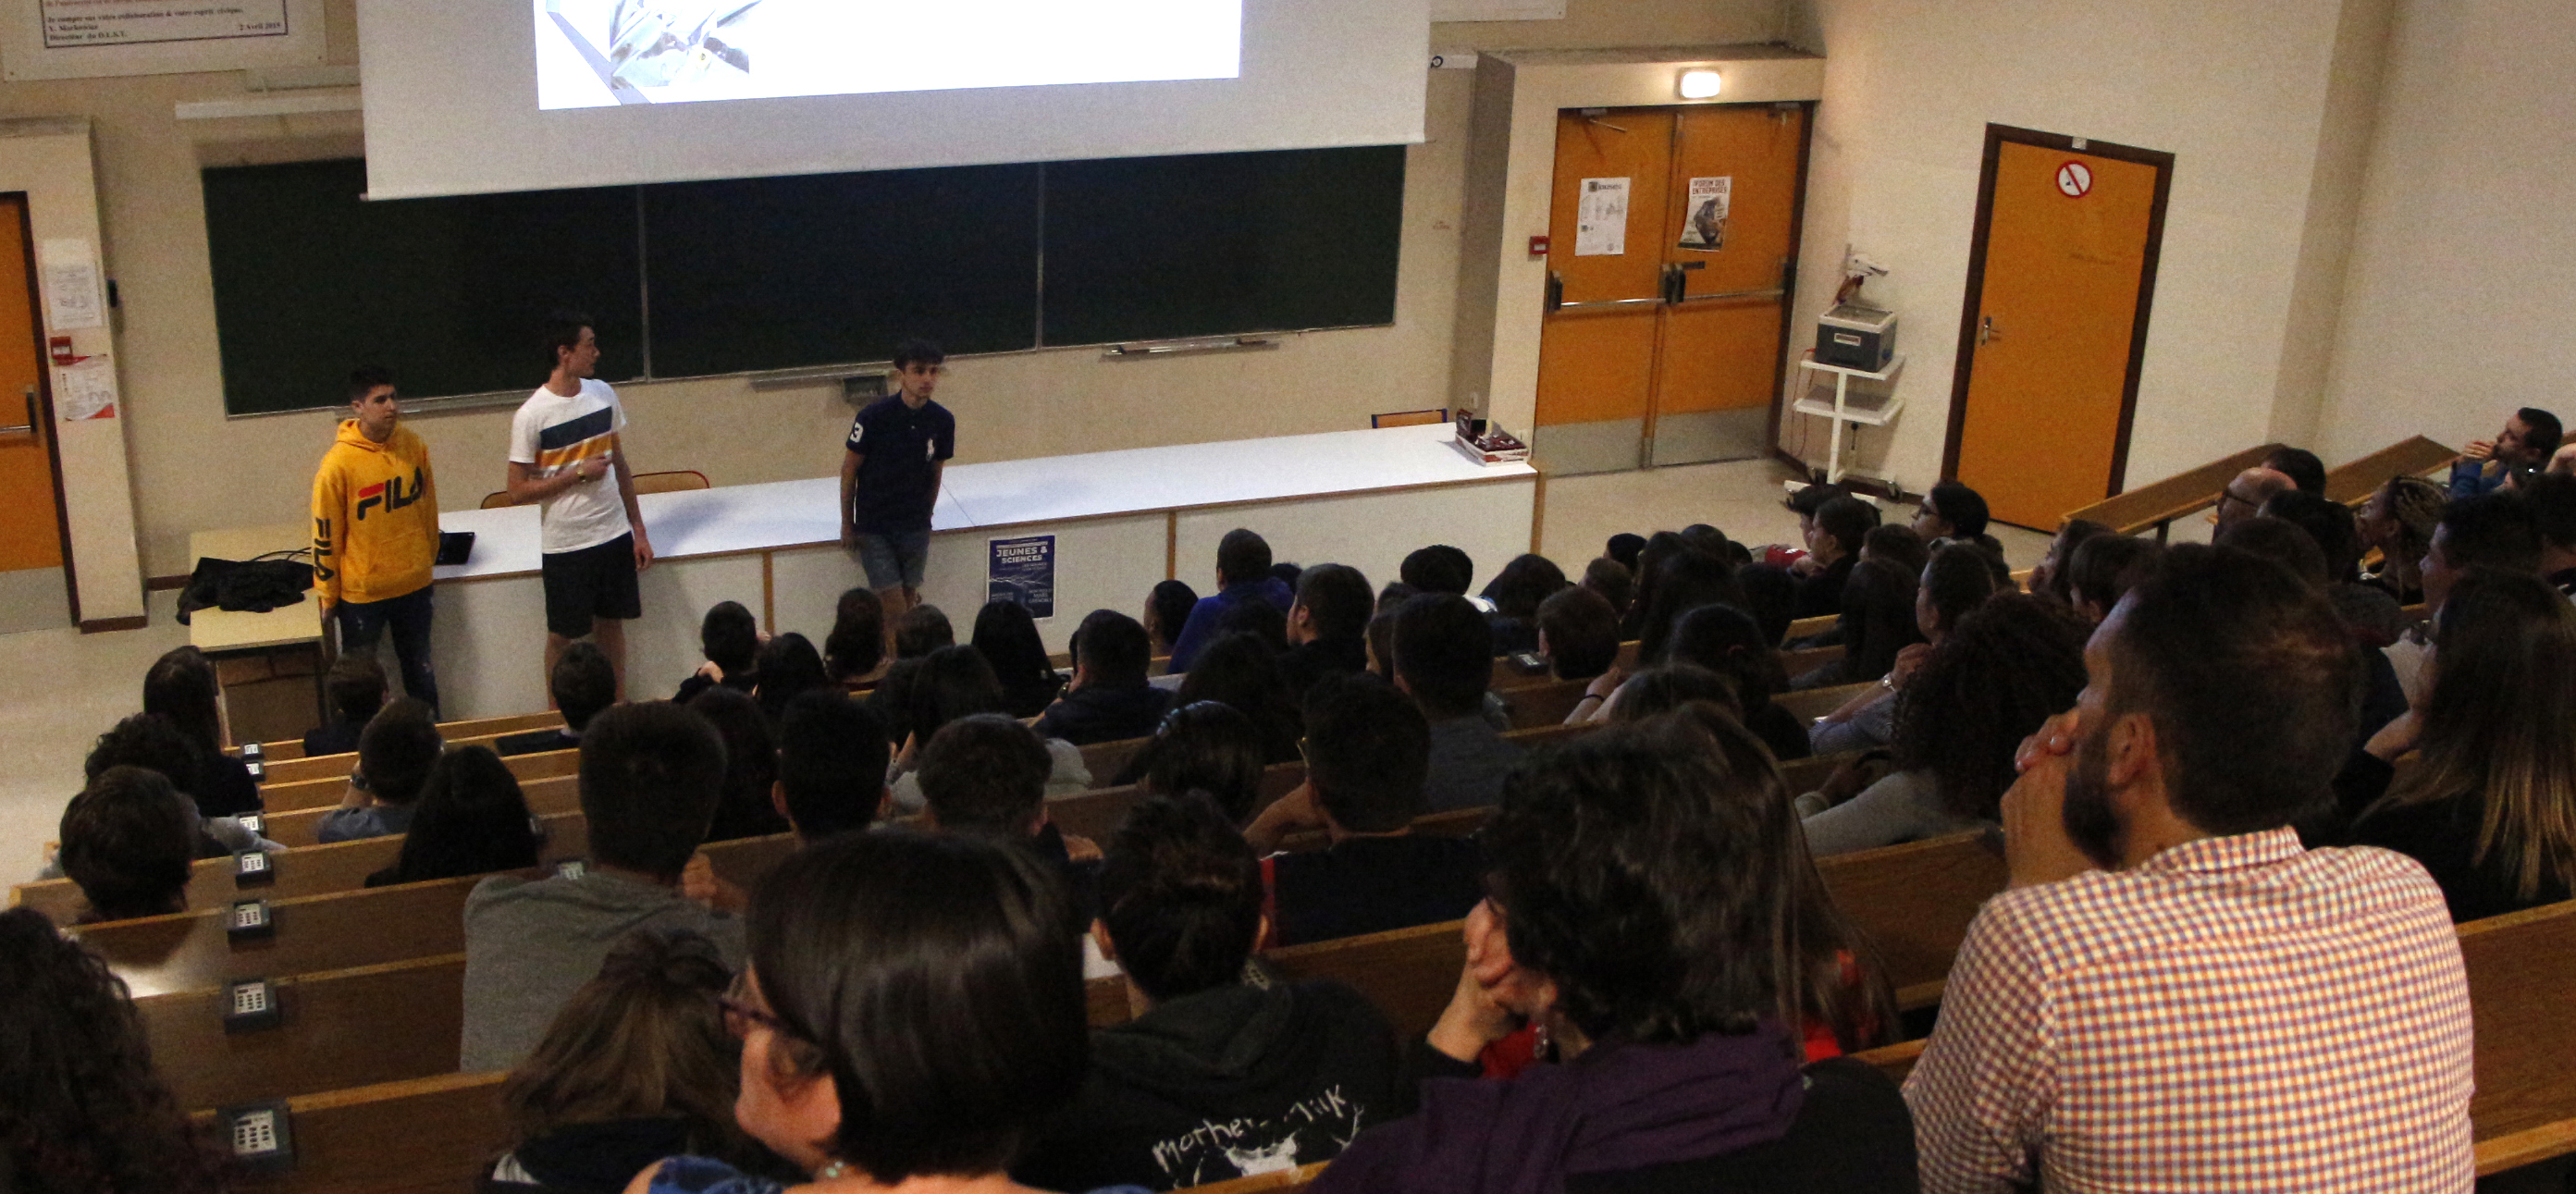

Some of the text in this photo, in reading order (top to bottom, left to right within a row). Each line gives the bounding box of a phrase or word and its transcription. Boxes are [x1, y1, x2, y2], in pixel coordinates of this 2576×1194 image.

[849, 422, 864, 443] 3
[357, 466, 424, 521] FILA
[314, 517, 335, 581] FILA
[996, 546, 1048, 557] JEUNES &
[1002, 555, 1042, 564] SCIENCES
